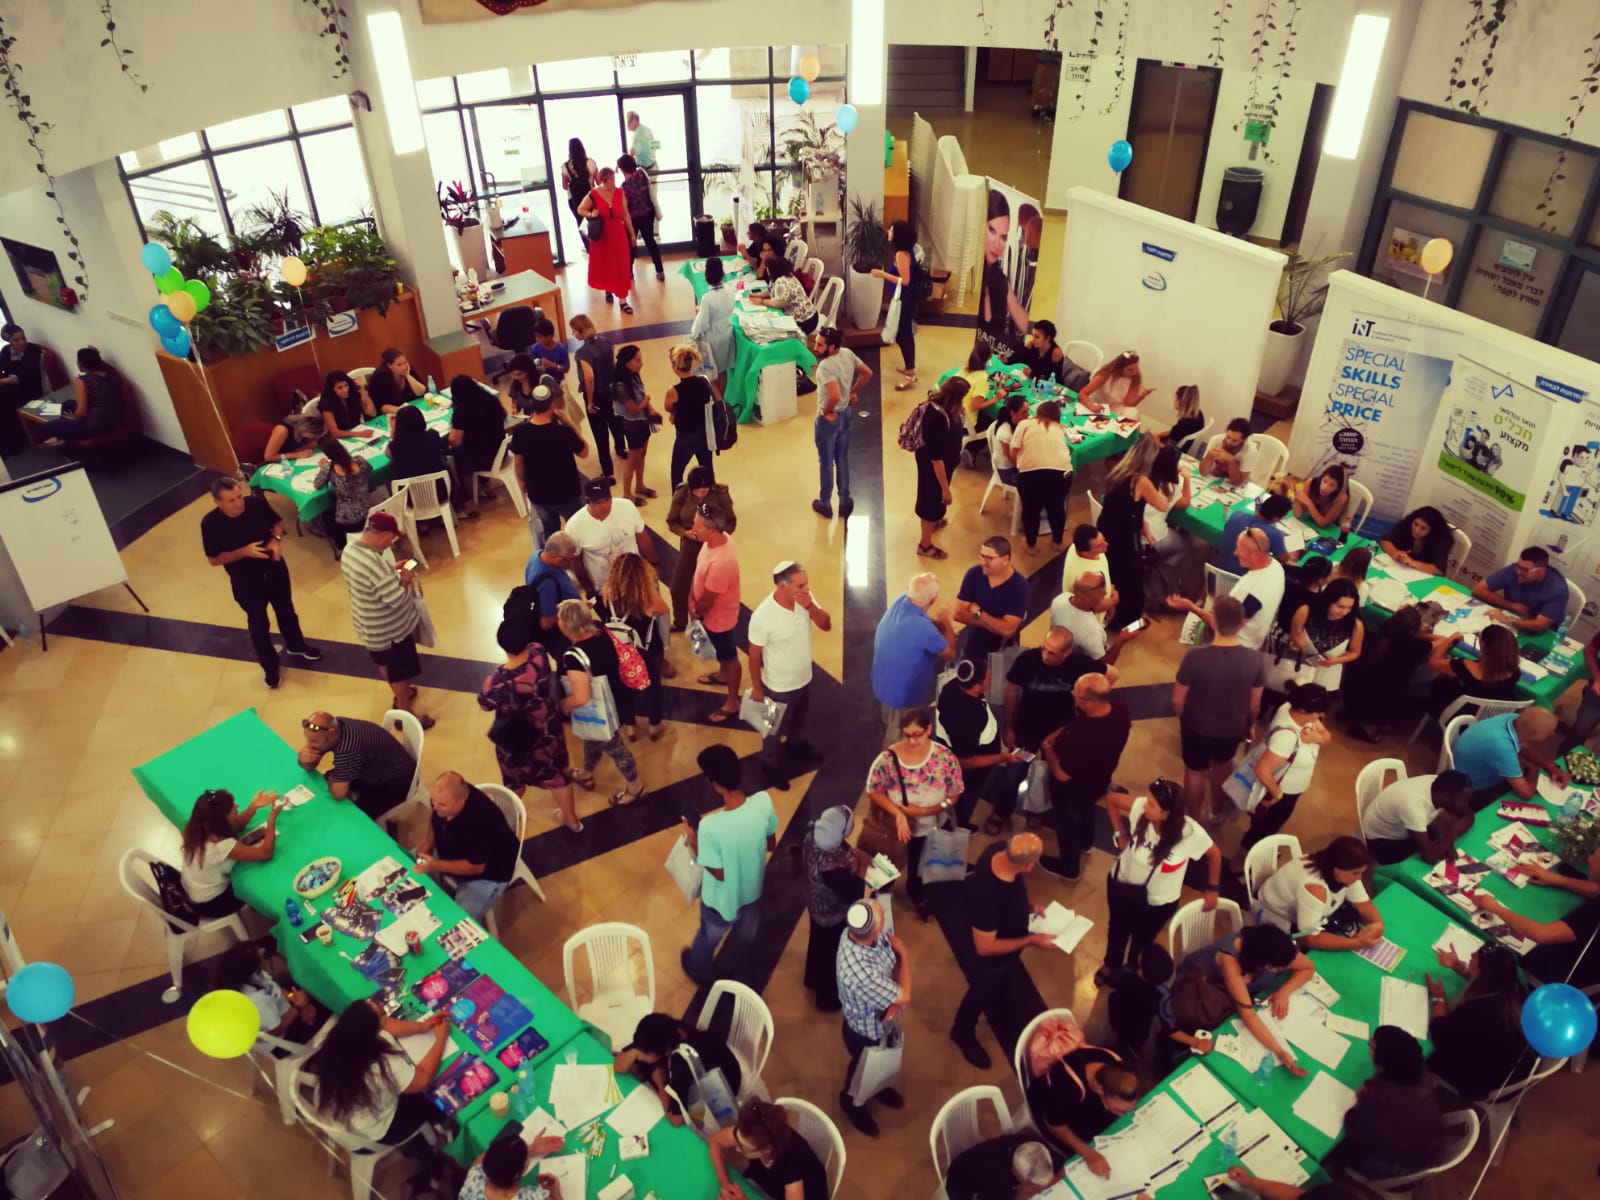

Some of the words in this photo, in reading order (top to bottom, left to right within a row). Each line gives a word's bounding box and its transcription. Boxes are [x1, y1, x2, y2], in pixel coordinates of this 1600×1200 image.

[1345, 347, 1406, 372] SPECIAL
[1341, 365, 1402, 390] SKILLS
[1336, 383, 1395, 408] SPECIAL
[1331, 400, 1382, 422] PRICE
[1499, 430, 1529, 452] מקצוע
